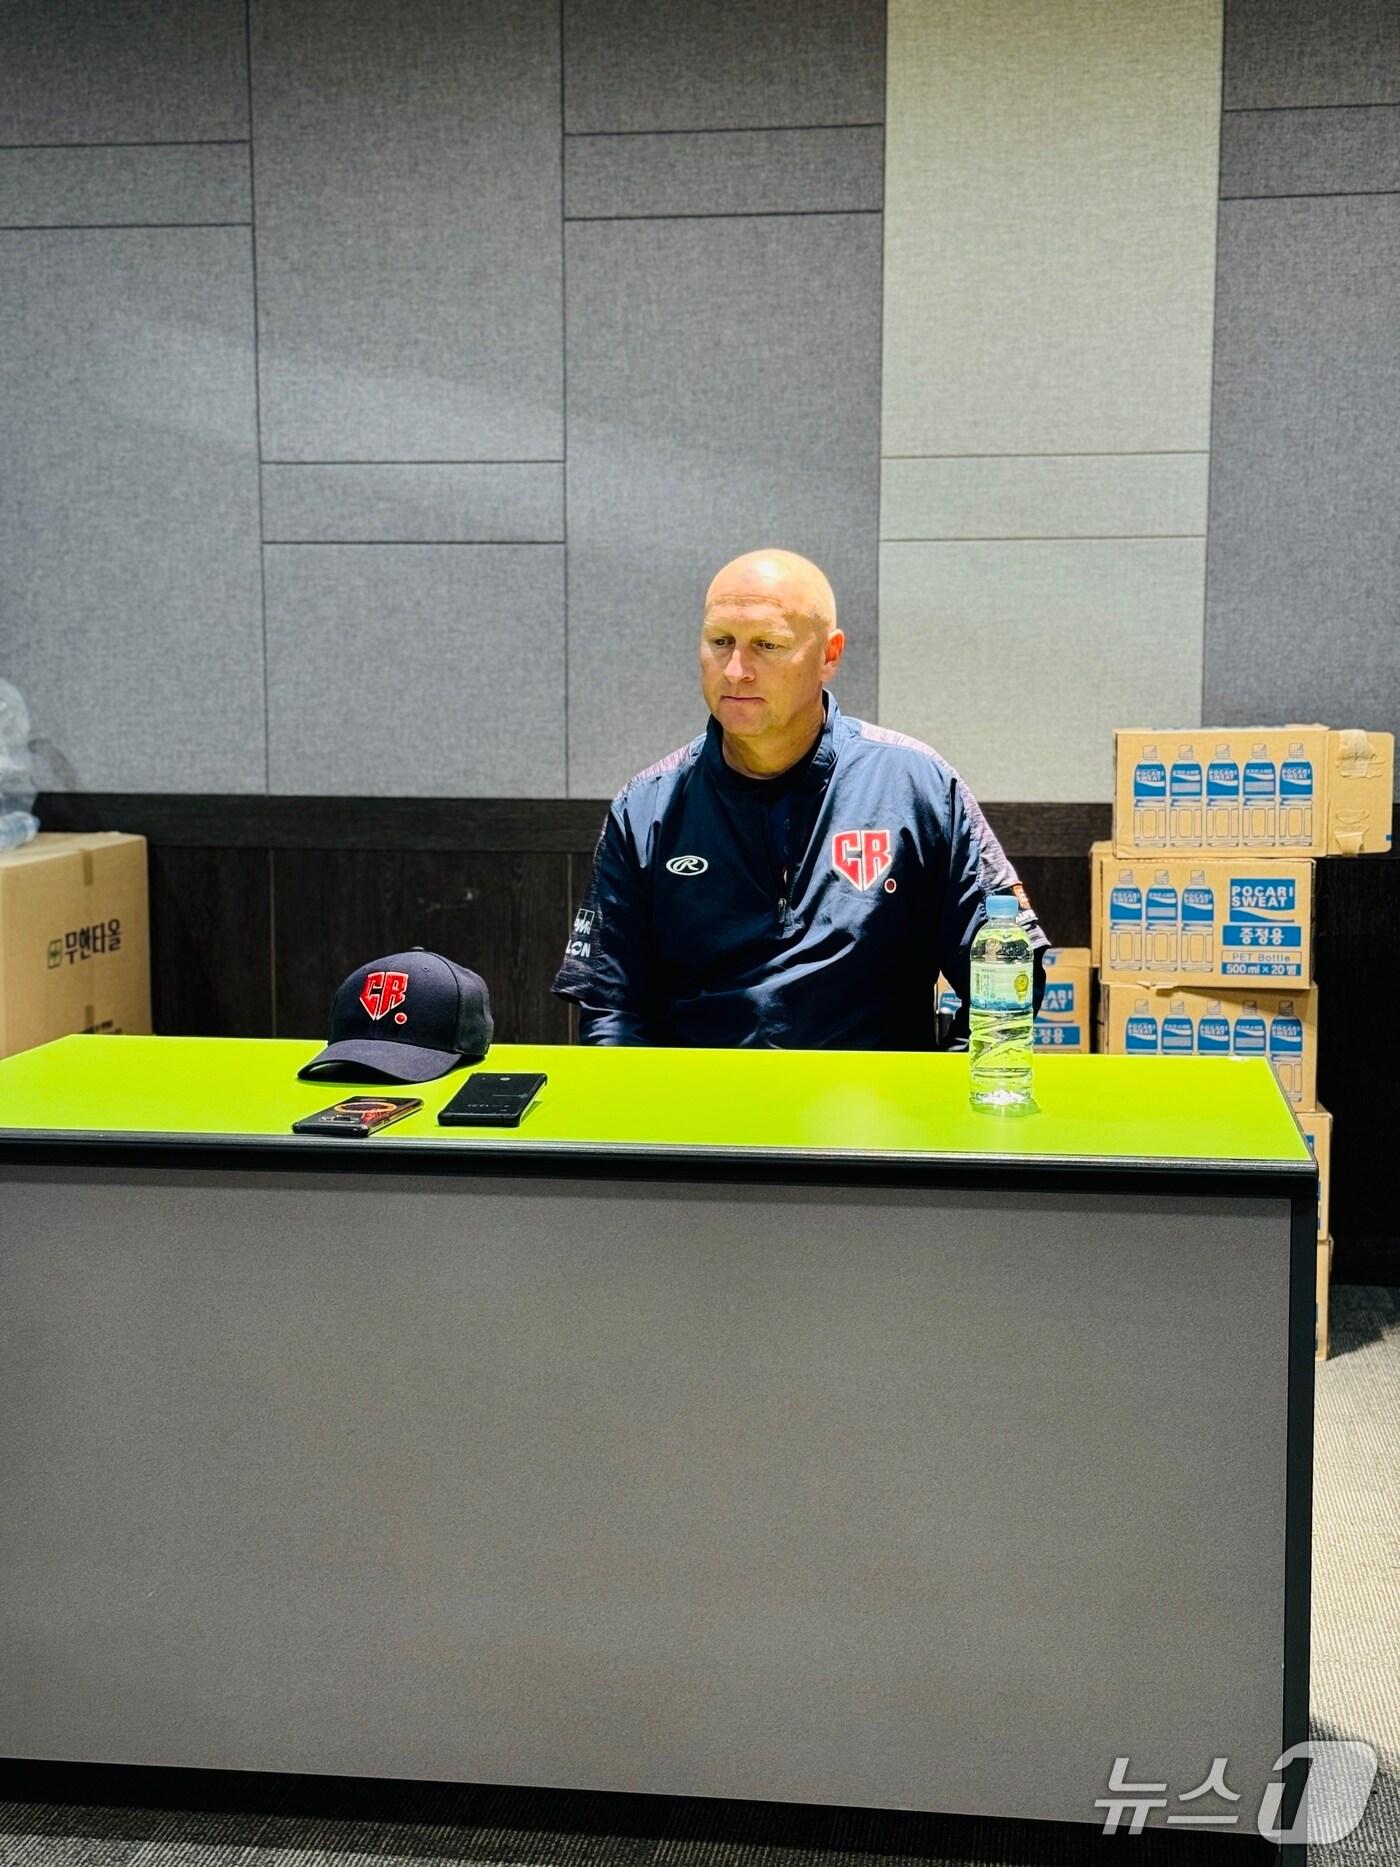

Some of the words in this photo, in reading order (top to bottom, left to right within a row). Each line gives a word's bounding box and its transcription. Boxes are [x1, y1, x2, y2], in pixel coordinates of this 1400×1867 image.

[1231, 885, 1293, 897] POCARI
[1231, 896, 1287, 908] SWEAT
[65, 918, 122, 965] 무한타올
[1239, 928, 1284, 945] 증정용
[1232, 953, 1252, 961] PET
[1258, 953, 1290, 963] Bottle
[1046, 990, 1073, 1000] ARI
[1041, 1000, 1068, 1010] EAT
